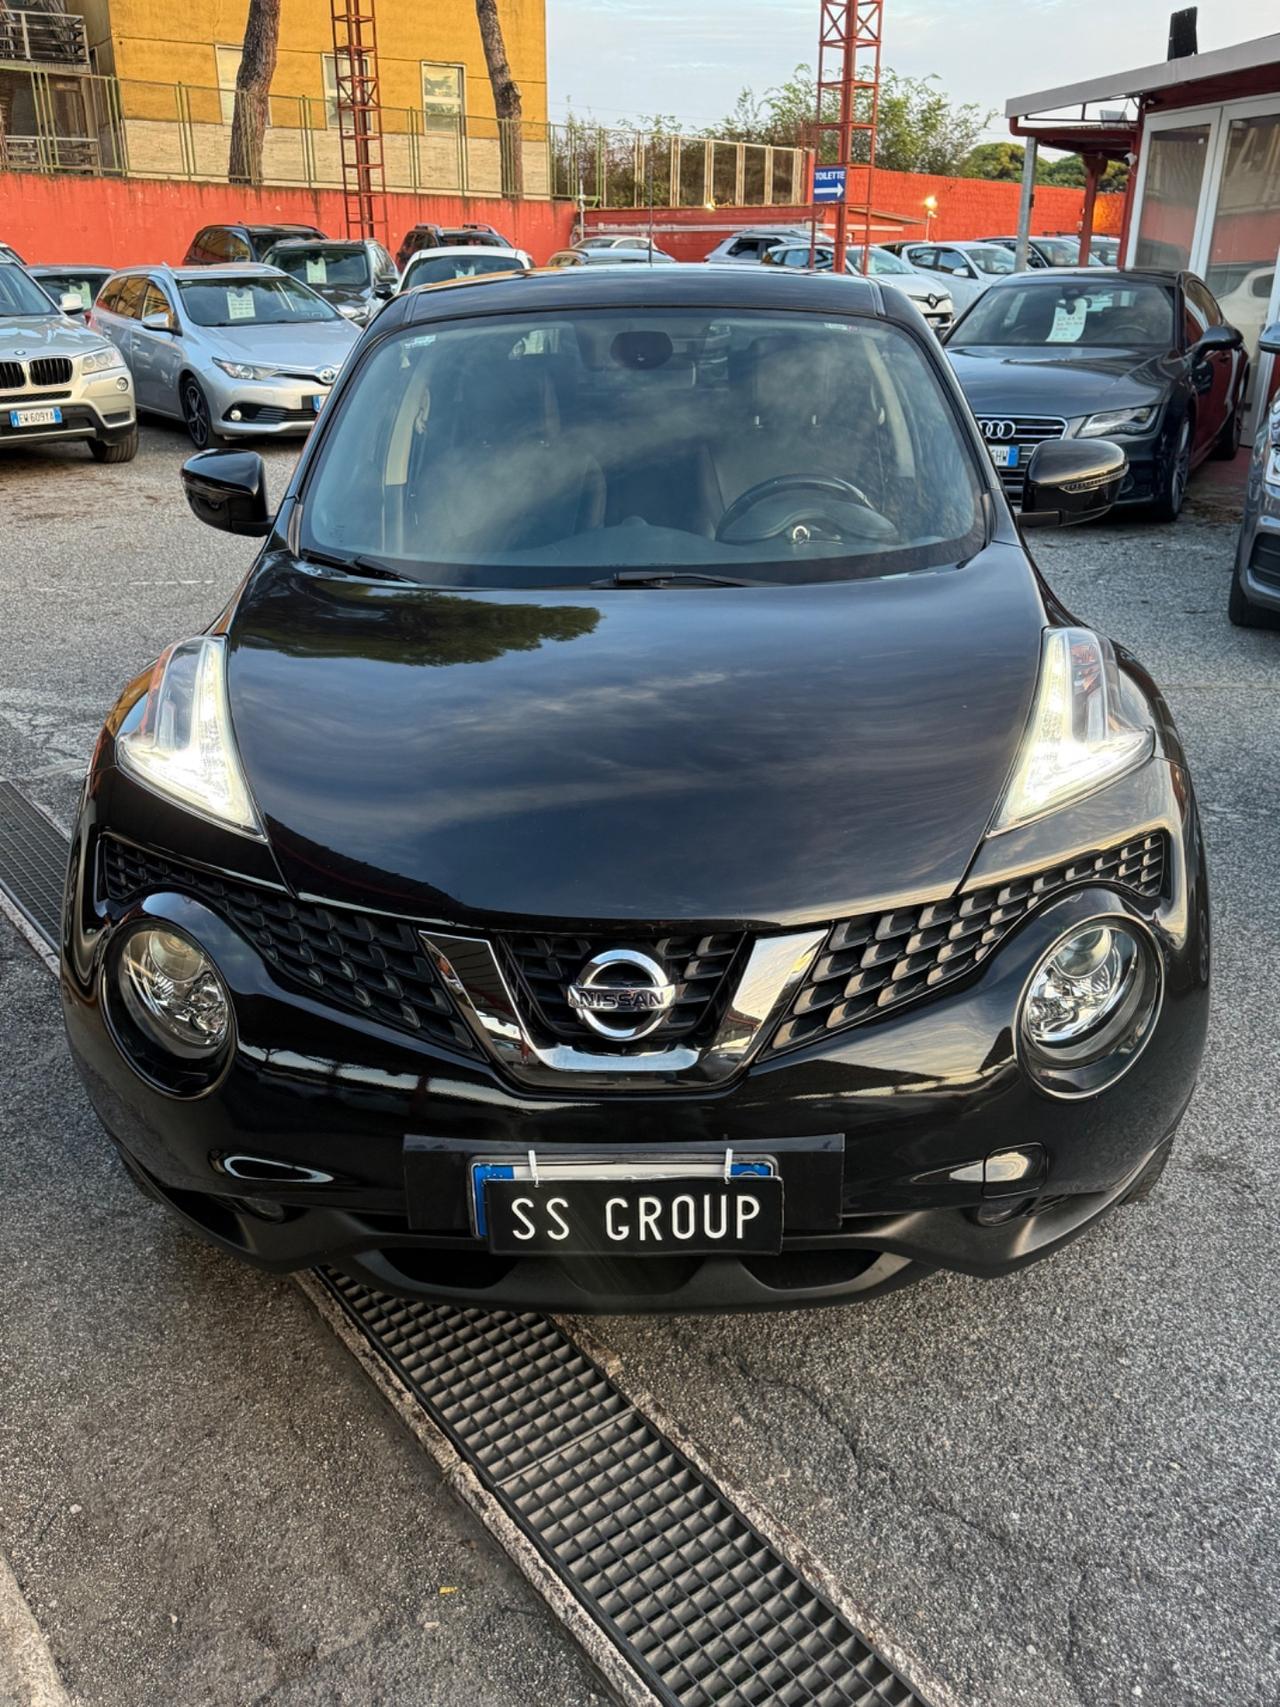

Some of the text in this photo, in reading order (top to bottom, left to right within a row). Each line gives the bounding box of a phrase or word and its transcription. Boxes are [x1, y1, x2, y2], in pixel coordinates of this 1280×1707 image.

[578, 990, 664, 1008] NISSAN
[511, 1194, 761, 1241] SS GROUP
